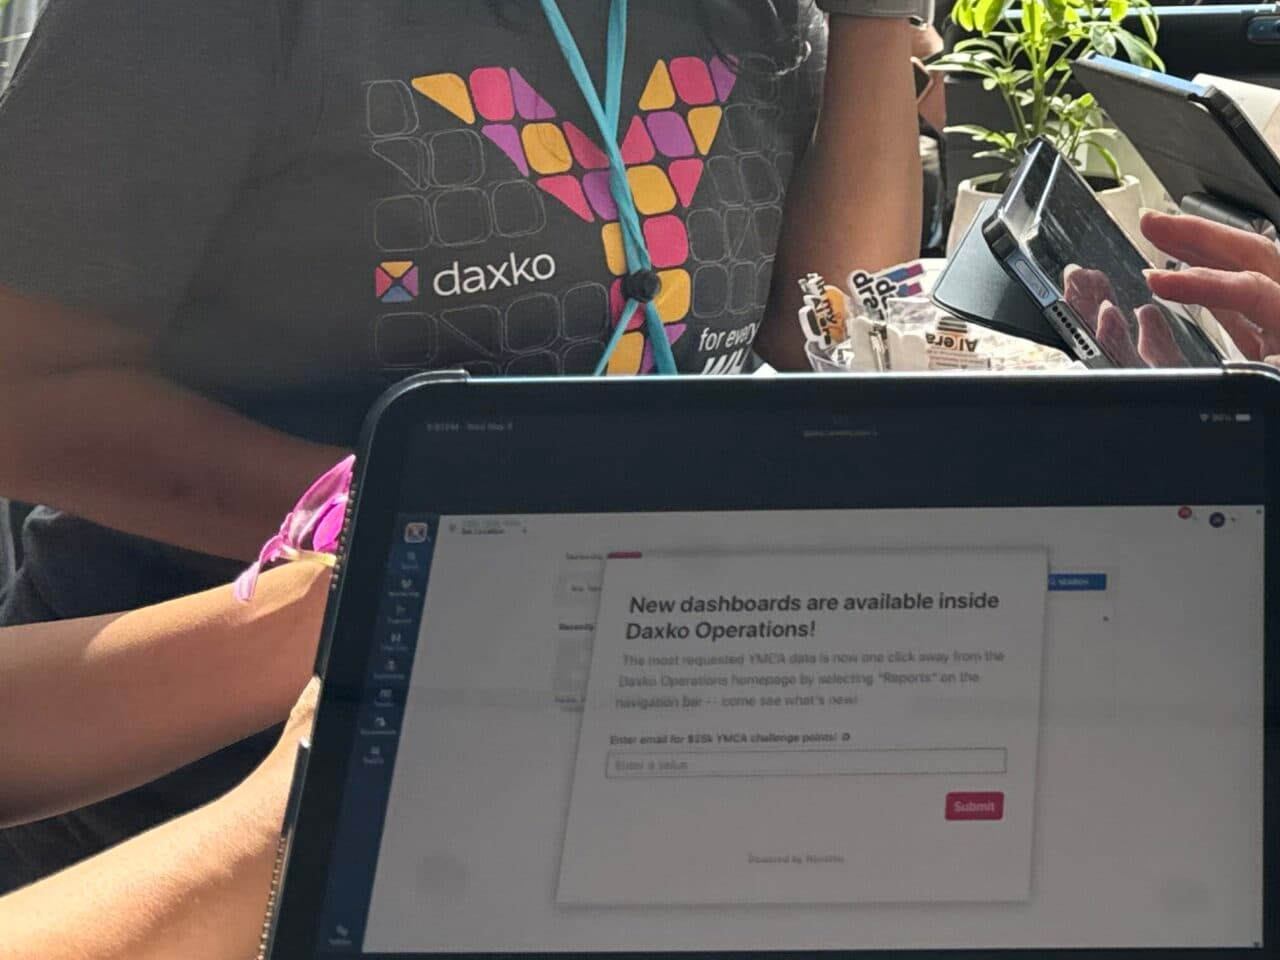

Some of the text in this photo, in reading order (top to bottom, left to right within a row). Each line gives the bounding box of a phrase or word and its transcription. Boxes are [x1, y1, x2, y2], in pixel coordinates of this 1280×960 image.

[433, 252, 556, 297] daxko
[698, 327, 726, 351] for
[628, 592, 1000, 613] New dashboards are available inside
[624, 620, 816, 642] Daxko Operations!
[622, 653, 645, 666] The
[647, 654, 680, 666] most
[681, 653, 744, 667] requested
[748, 652, 786, 665] YMCA
[788, 652, 816, 665] data
[831, 654, 859, 664] now
[861, 653, 885, 663] one
[887, 650, 915, 663] click
[918, 652, 949, 665] away
[952, 650, 982, 663] from
[983, 649, 1004, 662] the
[618, 675, 657, 688] Daxko
[660, 674, 728, 689] Operations
[730, 673, 796, 688] homepage
[798, 672, 814, 686] by
[817, 671, 874, 686] selecting
[940, 673, 957, 683] on
[958, 671, 980, 683] the
[615, 695, 680, 710] navigation
[758, 696, 782, 707] see
[609, 734, 637, 746] Enter
[639, 733, 667, 745] email
[669, 733, 685, 744] for
[716, 732, 748, 744] YMCA
[749, 731, 799, 746] challenge
[953, 800, 995, 813] Submit
